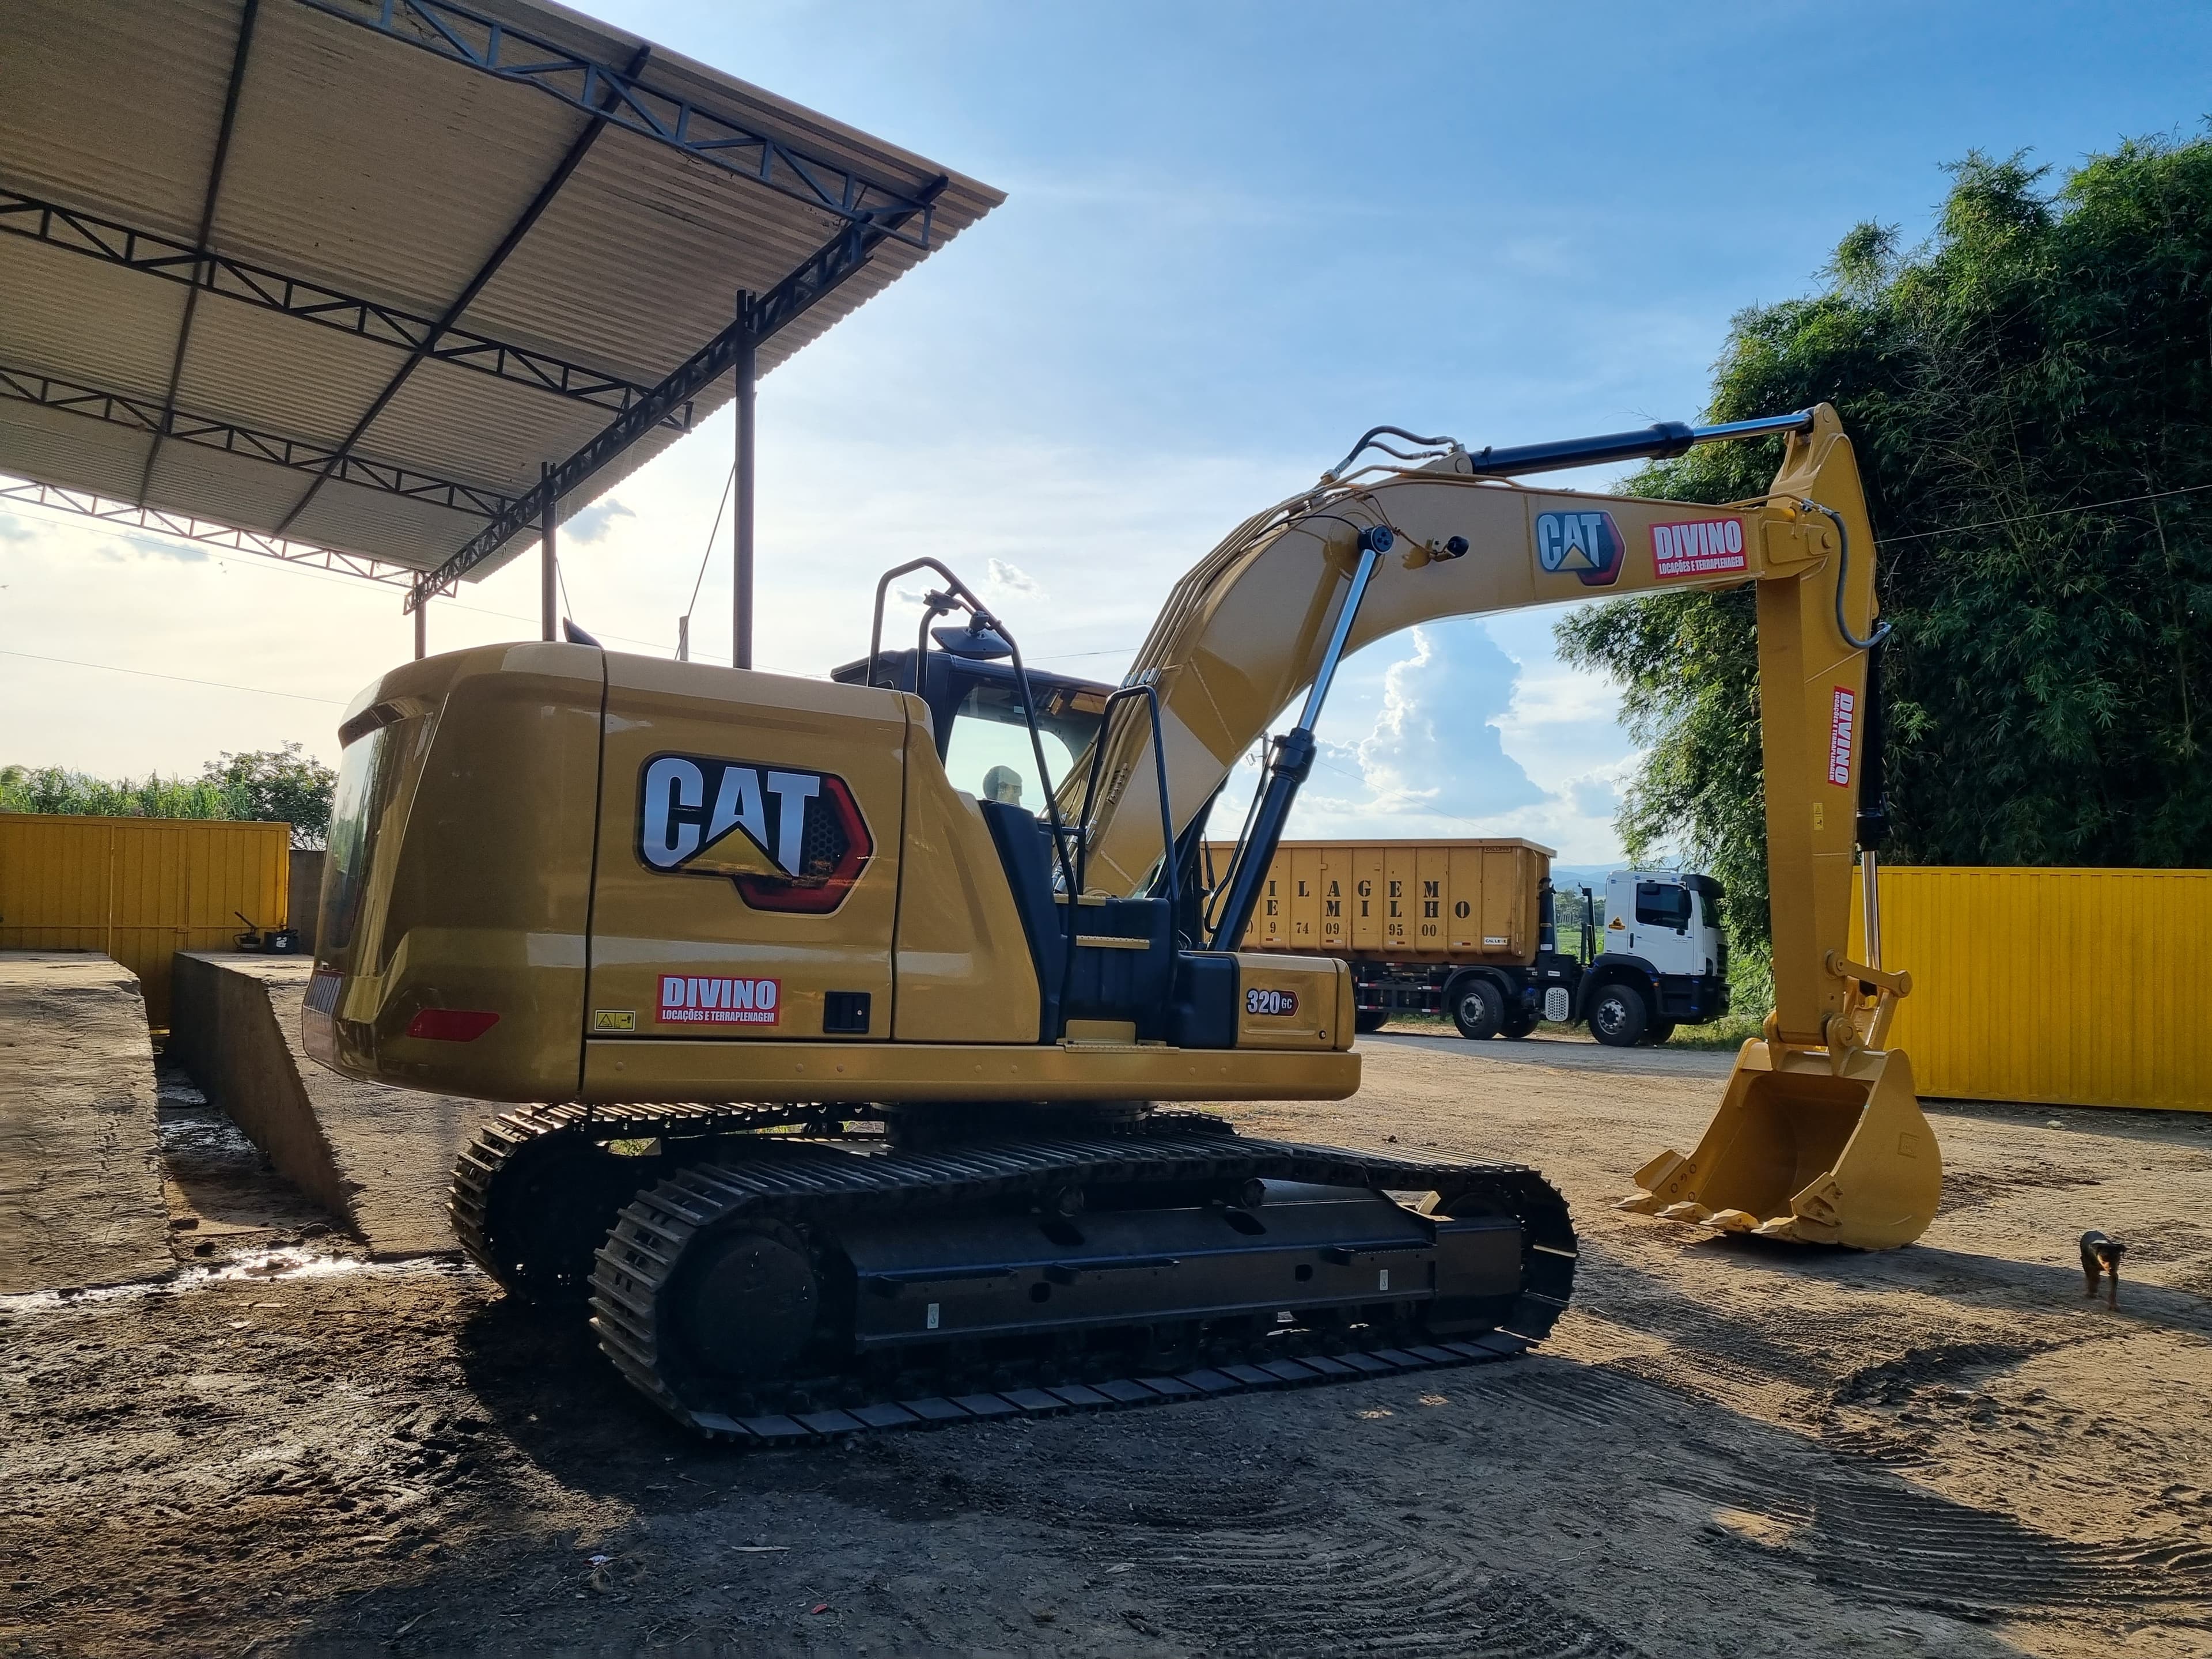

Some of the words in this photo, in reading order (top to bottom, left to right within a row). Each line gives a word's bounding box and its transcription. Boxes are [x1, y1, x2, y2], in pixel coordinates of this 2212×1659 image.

[1537, 514, 1601, 570] CAT
[1654, 520, 1743, 560] DIVINO
[1658, 559, 1691, 575] LOCAÇÕES
[1691, 560, 1696, 571] E
[1695, 556, 1744, 570] TERRAPLENAGEM
[1835, 692, 1854, 785] DIVINO
[643, 757, 820, 877] CAT
[1268, 880, 1440, 898] ILAGEM
[1266, 900, 1278, 916] E
[1325, 900, 1471, 918] MILHO
[662, 977, 777, 1010] DIVINO
[1247, 990, 1281, 1014] 320
[1281, 998, 1293, 1009] GC
[662, 1009, 703, 1022] LOCAÇÕES
[704, 1011, 711, 1021] E
[711, 1011, 775, 1022] TERRAPLENAGEM
